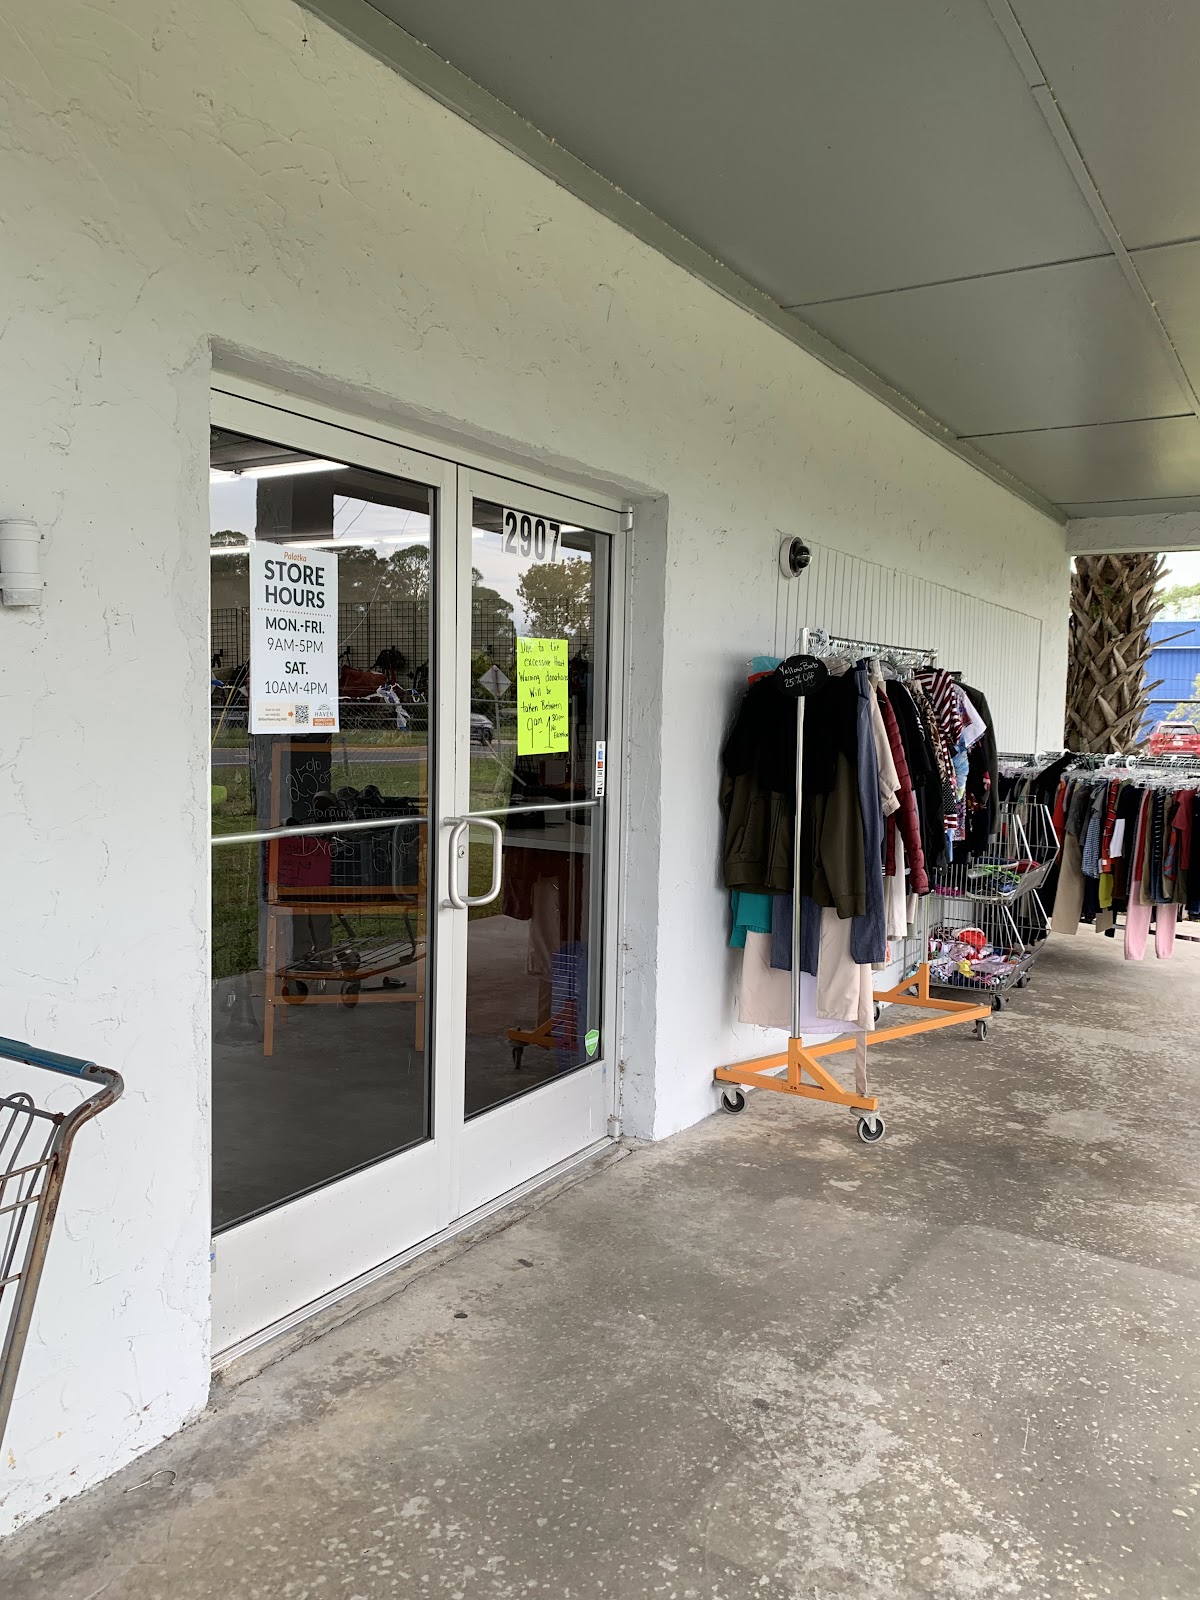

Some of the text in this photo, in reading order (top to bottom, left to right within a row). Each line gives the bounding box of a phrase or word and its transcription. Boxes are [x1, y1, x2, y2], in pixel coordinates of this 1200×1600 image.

[505, 511, 560, 562] 2907
[283, 551, 307, 562] Palatka
[264, 559, 325, 587] STORE
[265, 584, 325, 609] HOURS
[265, 616, 325, 634] MON.-FRI.
[267, 637, 324, 654] 9AM-5PM
[538, 640, 545, 652] to
[285, 661, 309, 675] SAT.
[264, 680, 328, 695] 10AM-4PM
